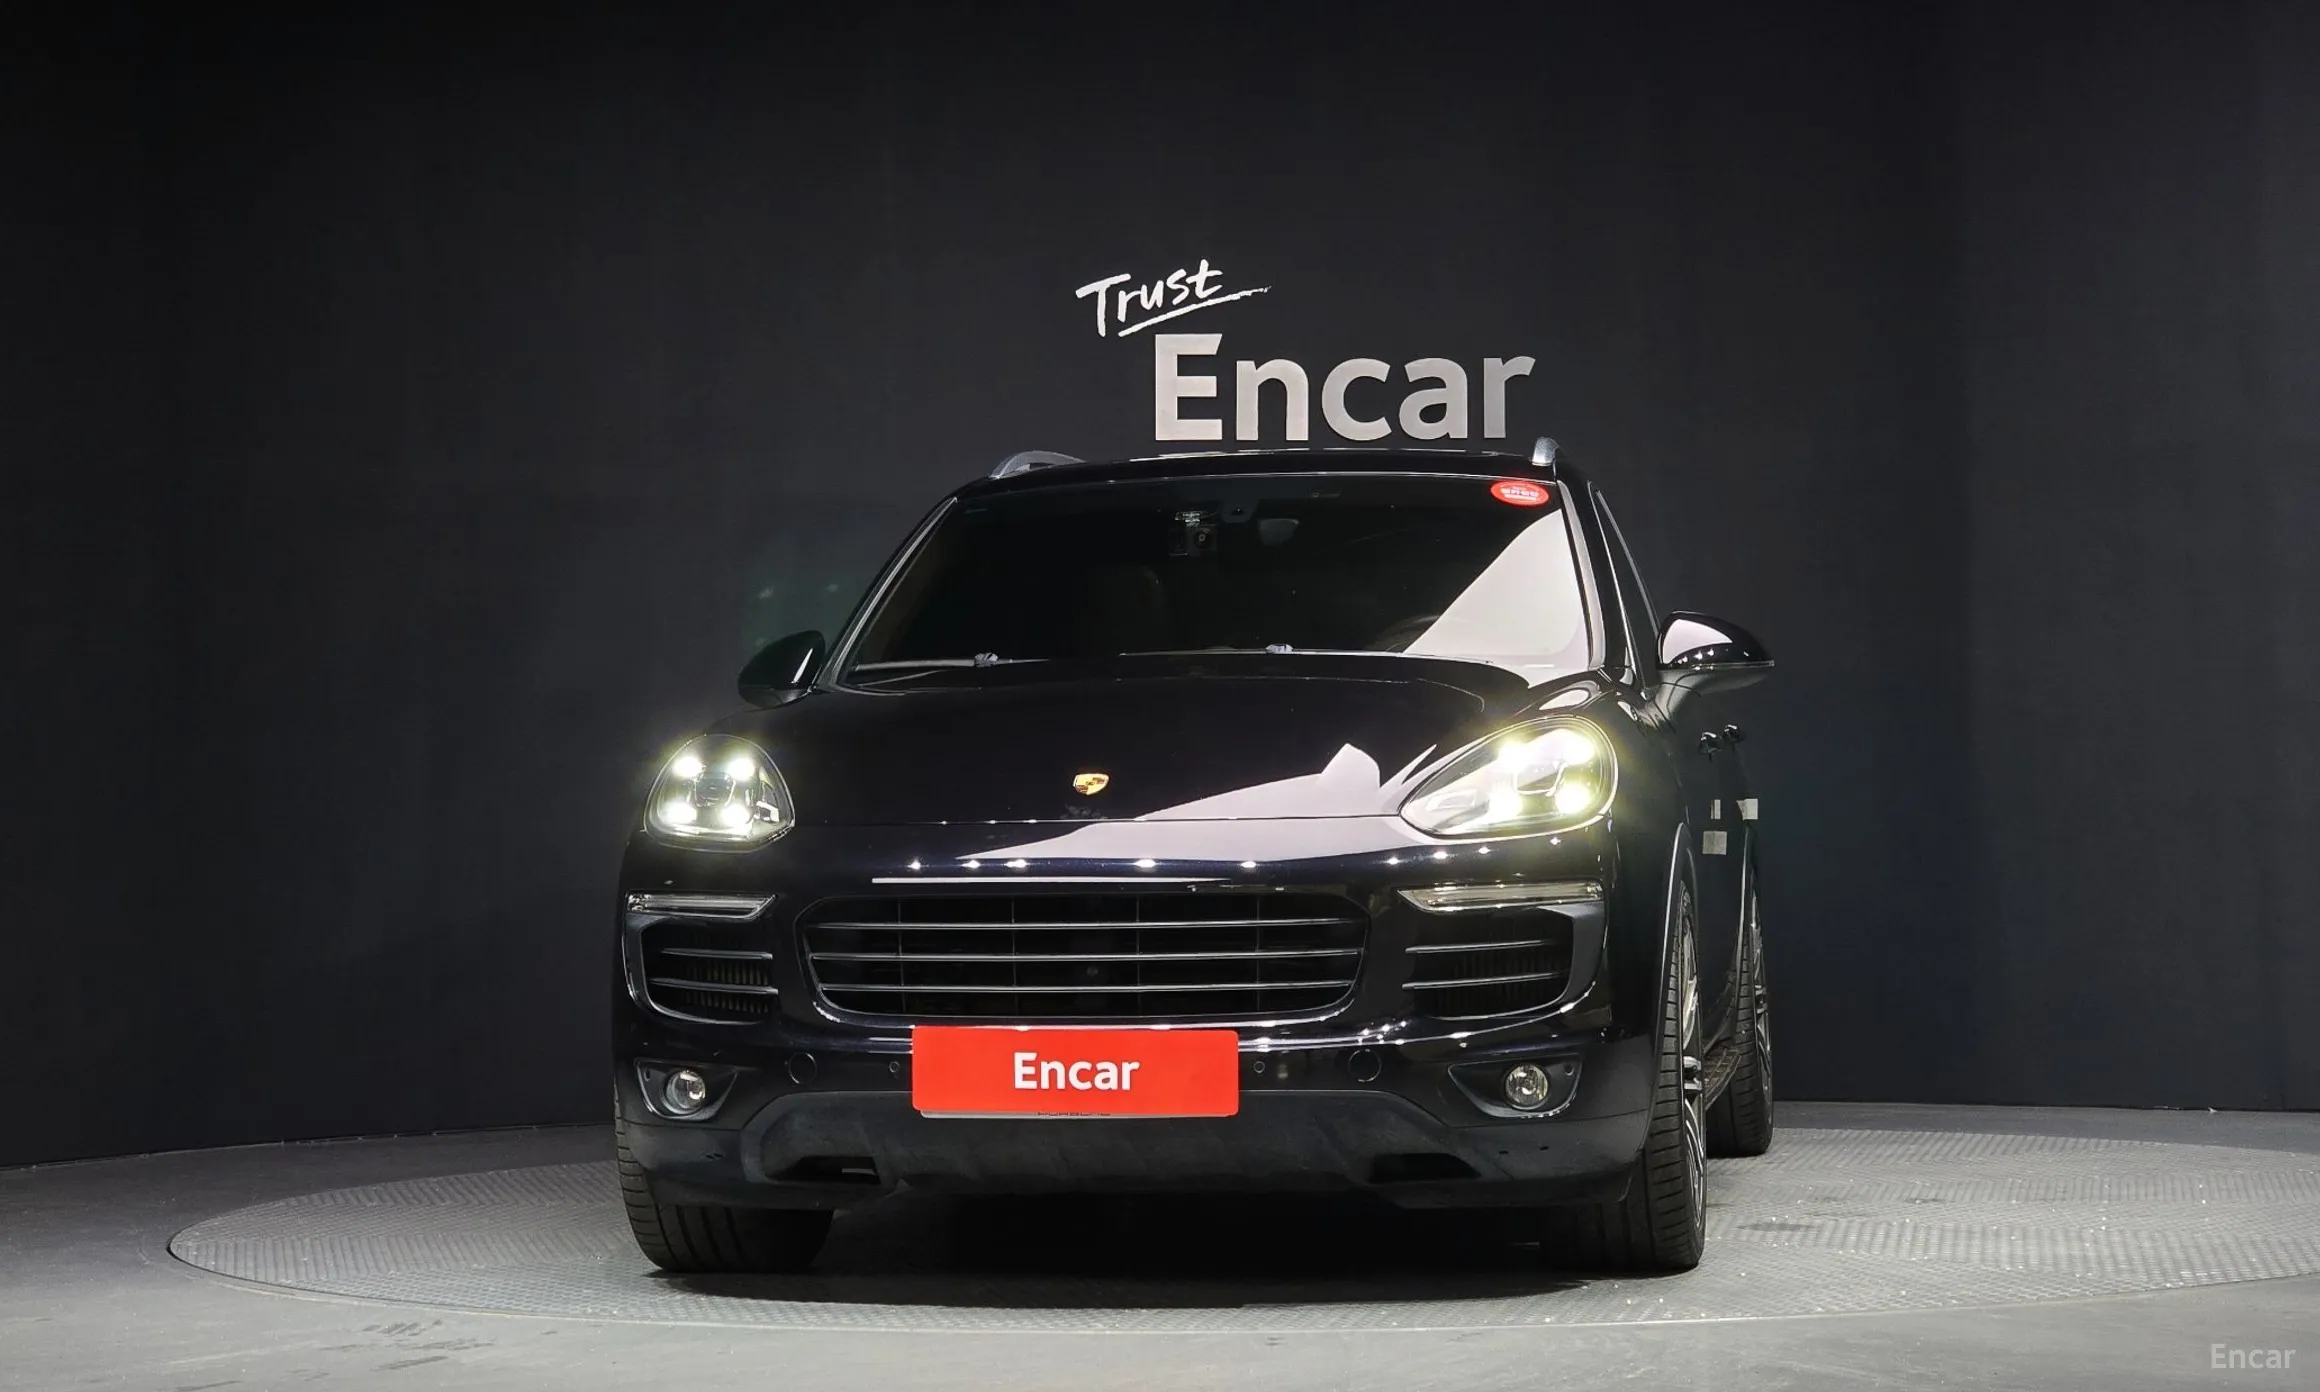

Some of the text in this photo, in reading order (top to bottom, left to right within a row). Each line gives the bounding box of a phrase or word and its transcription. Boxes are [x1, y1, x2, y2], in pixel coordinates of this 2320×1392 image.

[1075, 258, 1226, 338] Trust
[1155, 333, 1536, 441] Encar
[1013, 1052, 1140, 1091] Encar
